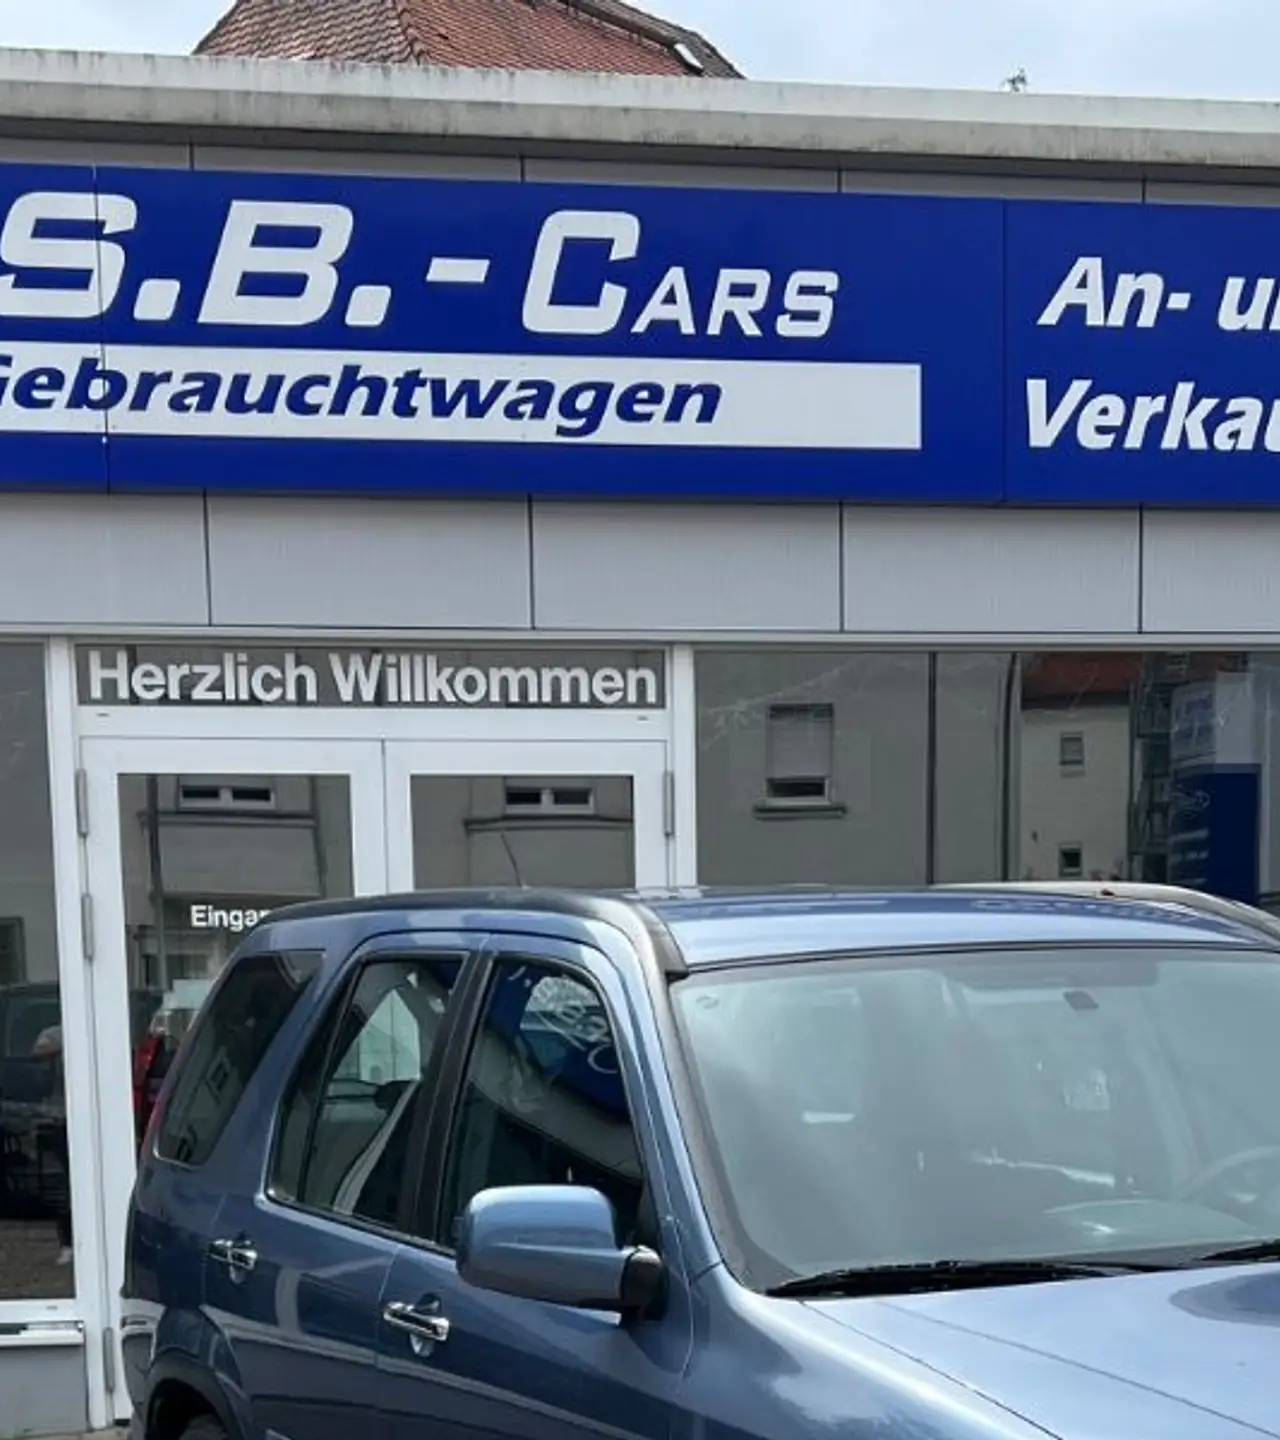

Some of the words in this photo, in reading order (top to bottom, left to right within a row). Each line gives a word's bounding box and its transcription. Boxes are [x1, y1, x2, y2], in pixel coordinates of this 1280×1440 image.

[1037, 256, 1191, 328] An-
[89, 650, 318, 702] Herzlich
[328, 652, 658, 704] Willkommen
[190, 904, 272, 932] Einga
